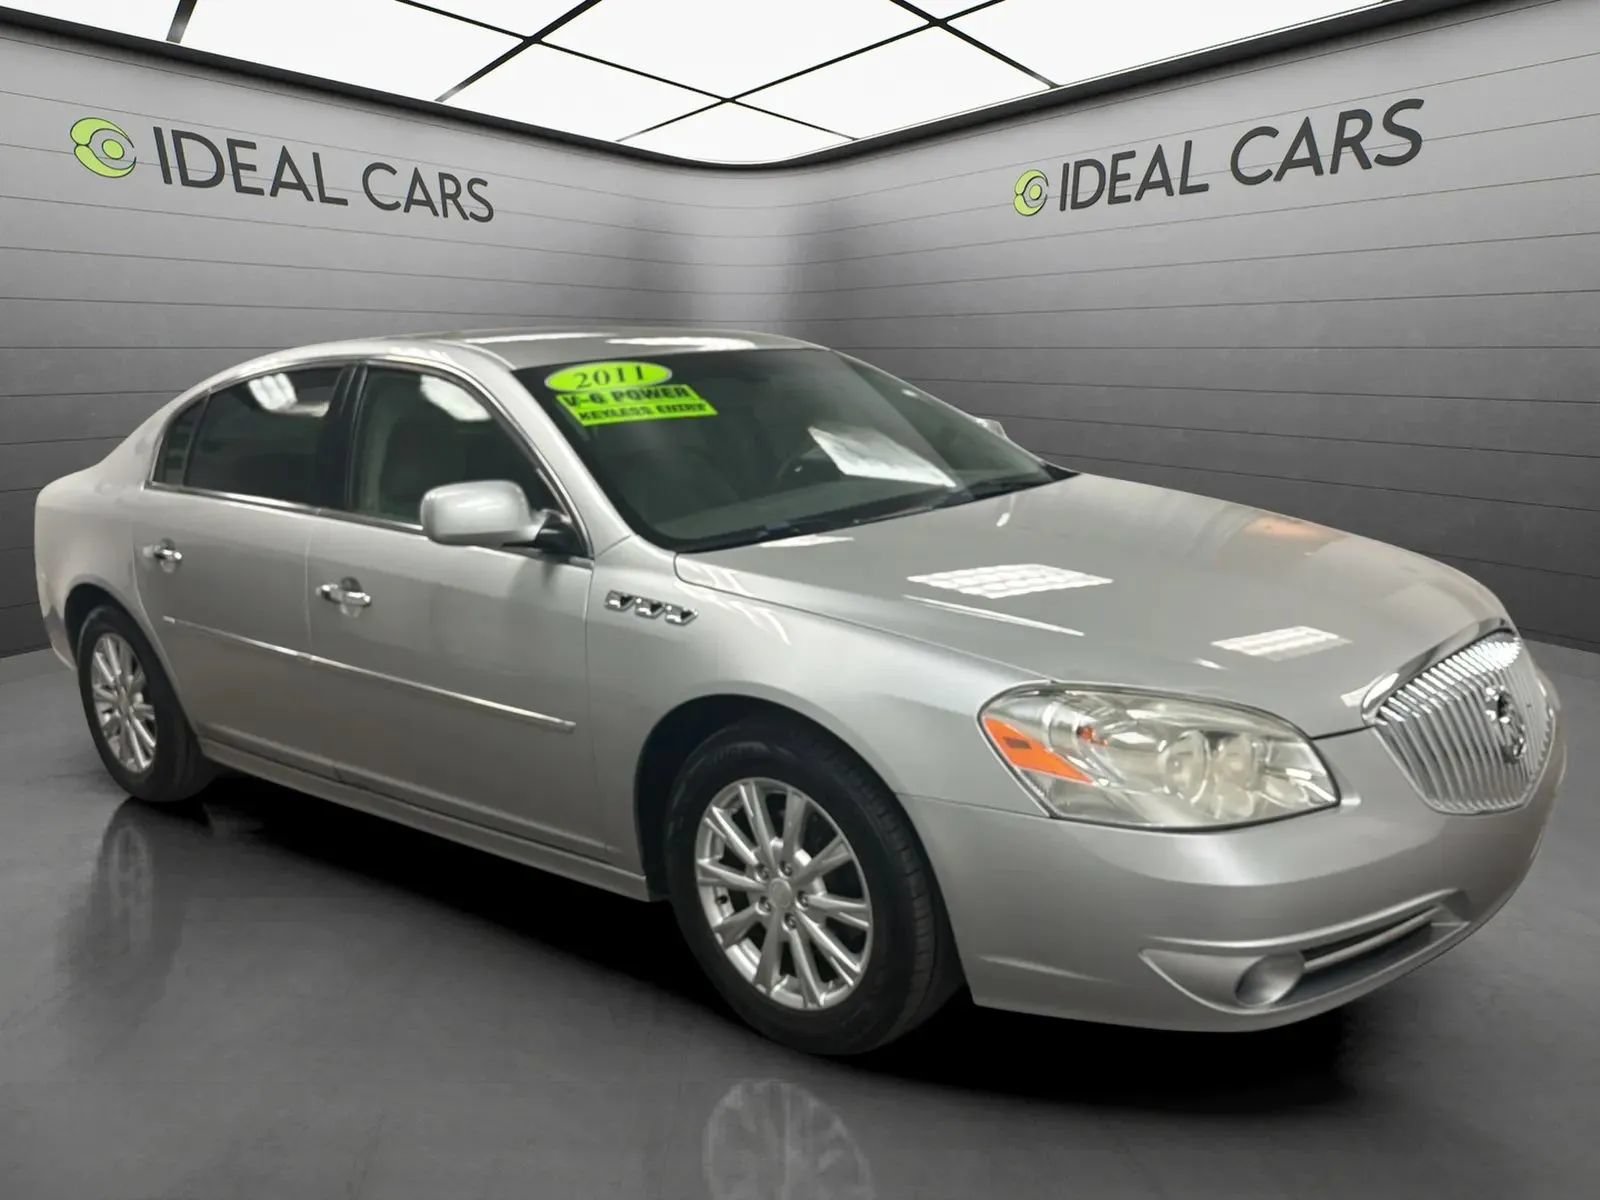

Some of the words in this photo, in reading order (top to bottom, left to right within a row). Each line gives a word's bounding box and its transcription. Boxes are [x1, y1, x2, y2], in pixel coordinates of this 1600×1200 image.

[1059, 140, 1209, 211] IDEAL
[1230, 98, 1425, 186] CARS
[152, 126, 349, 206] IDEAL
[361, 162, 495, 223] CARS
[573, 365, 645, 389] 2011
[562, 391, 605, 408] V-6
[610, 386, 691, 403] POWER
[578, 405, 654, 421] KEYLESS
